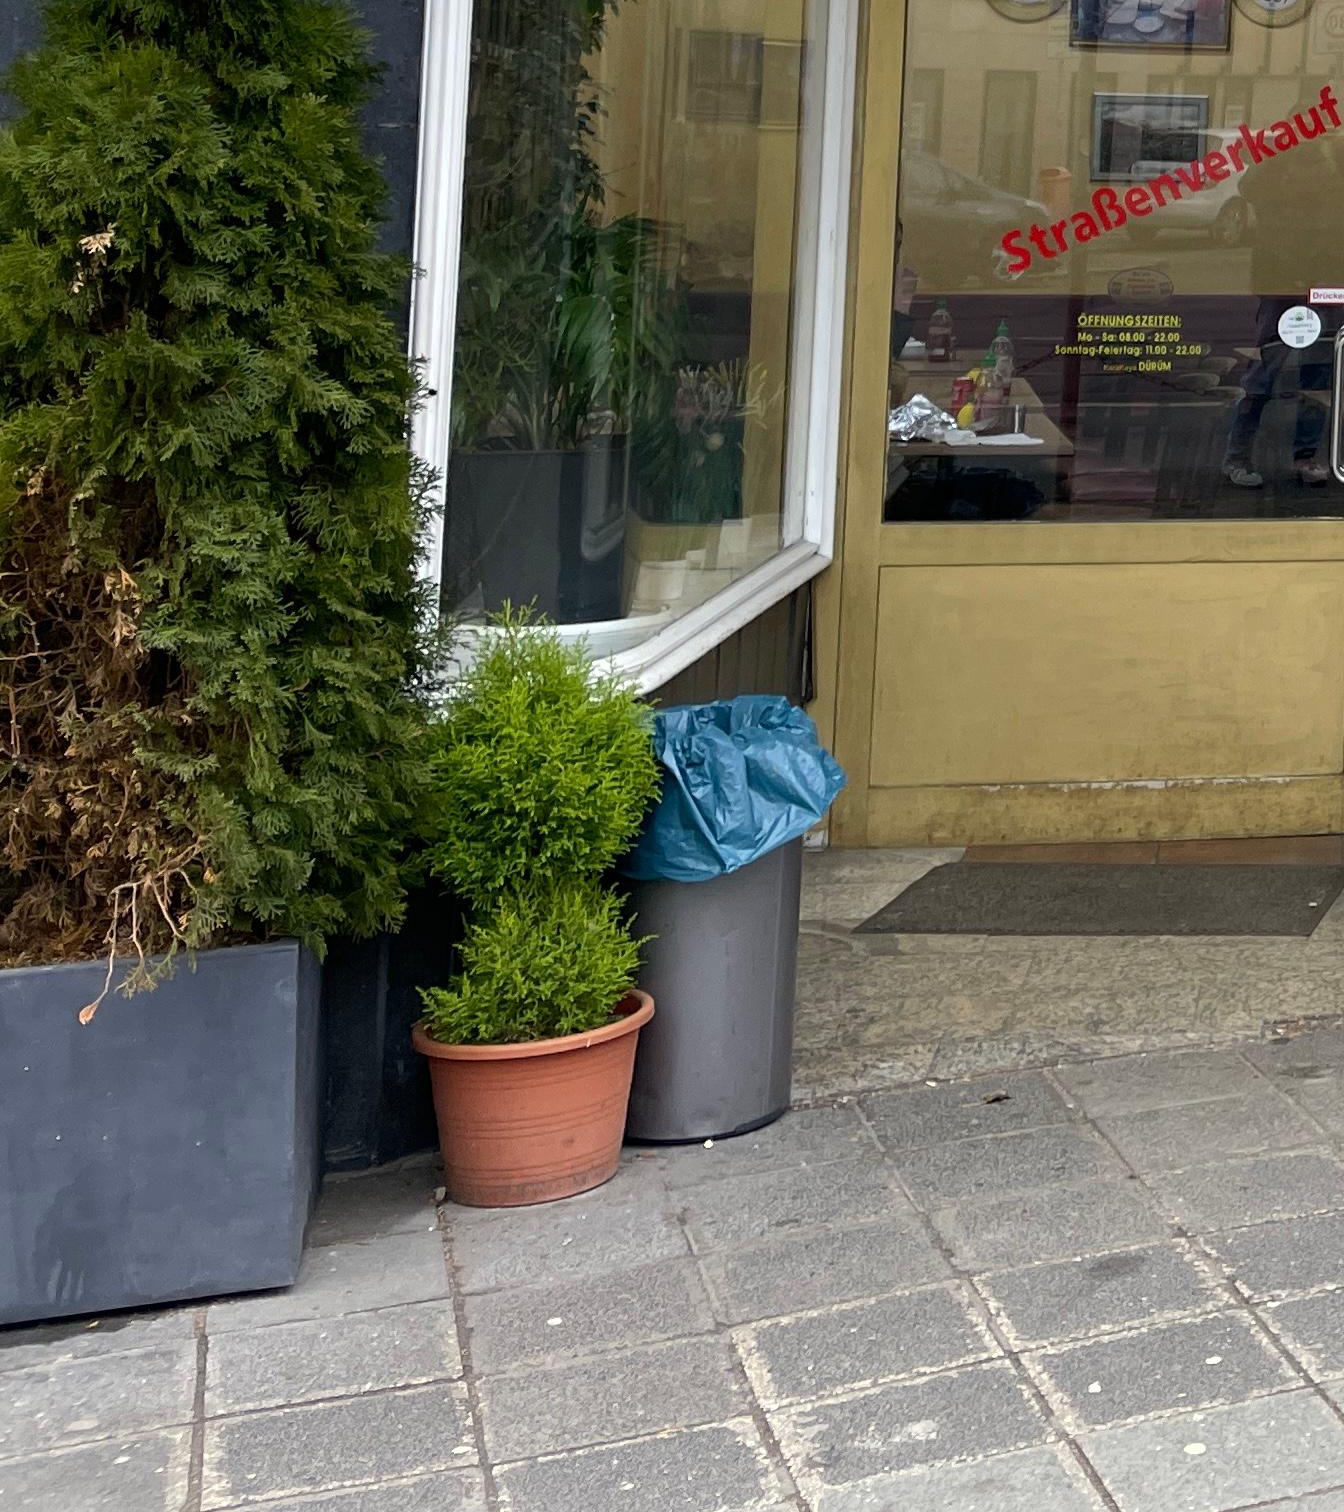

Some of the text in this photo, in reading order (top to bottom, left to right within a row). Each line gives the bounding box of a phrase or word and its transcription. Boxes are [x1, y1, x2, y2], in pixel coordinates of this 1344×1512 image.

[1001, 85, 1342, 274] Straßenverkauf
[1077, 313, 1181, 327] ÖFFNUNGSZEITEN:
[1077, 332, 1093, 342] Mo
[1102, 332, 1116, 342] Sa:
[1138, 360, 1171, 372] DÜRÜM
